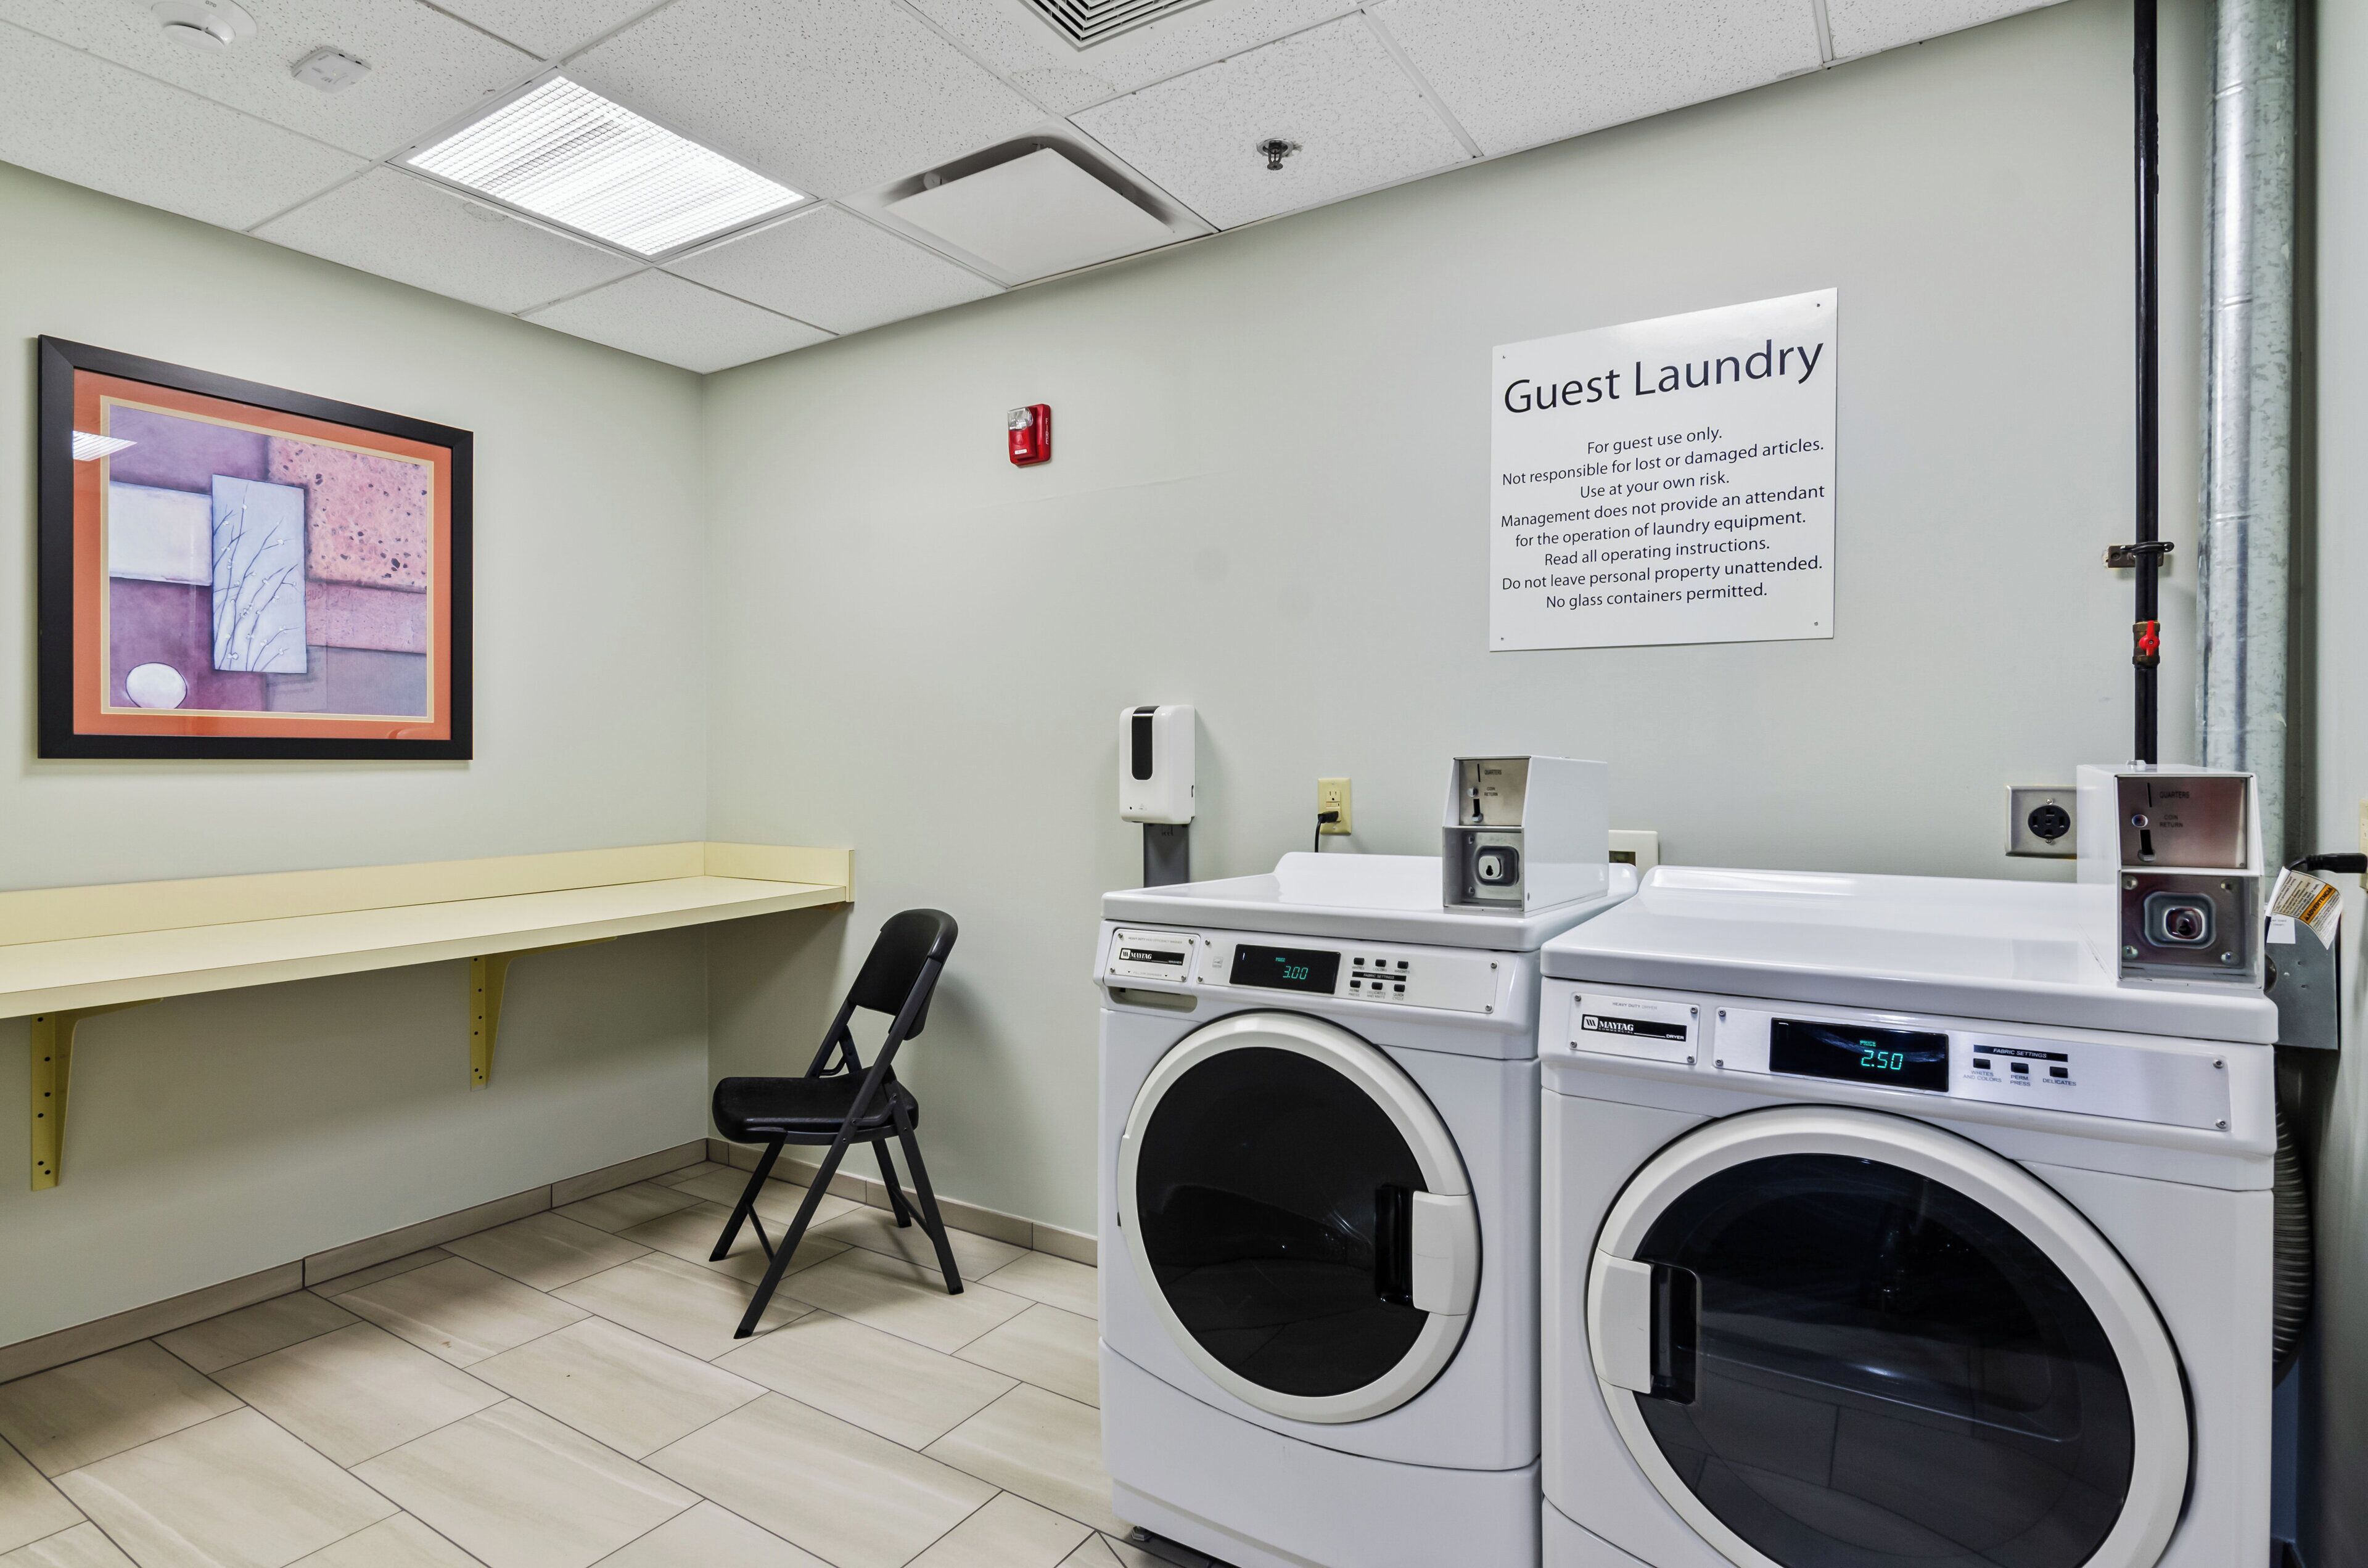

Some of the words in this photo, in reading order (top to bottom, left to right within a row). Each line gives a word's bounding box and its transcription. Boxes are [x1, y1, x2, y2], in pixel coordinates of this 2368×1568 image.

[1505, 369, 1621, 413] Guest
[1635, 339, 1824, 396] Laundry
[1588, 441, 1610, 454] For
[1613, 436, 1653, 454] guest
[1658, 434, 1682, 445] use
[1687, 427, 1722, 443] only.
[1503, 473, 1526, 486] Not
[1531, 462, 1608, 483] responsible
[1612, 460, 1632, 474] for
[1635, 458, 1661, 470] lost
[1665, 456, 1681, 467] or
[1685, 443, 1758, 465] damaged
[1762, 438, 1823, 456] articles.
[1581, 486, 1605, 498] Use
[1610, 483, 1622, 495] at
[1627, 481, 1659, 497] your
[1663, 477, 1695, 490] own
[1700, 470, 1729, 486] risk.
[1501, 509, 1590, 528] Management
[1594, 506, 1627, 519] does
[1632, 502, 1656, 515] not
[1661, 495, 1717, 515] provide
[1722, 496, 1740, 507] an
[1745, 486, 1825, 504] attendant
[1516, 534, 1534, 547] for
[1537, 532, 1559, 545] the
[1563, 527, 1630, 545] operation
[1634, 522, 1650, 536] of
[1653, 519, 1710, 535] laundry
[1714, 512, 1806, 532] equipment.
[1545, 551, 1577, 566] Read
[1582, 549, 1597, 563] all
[1601, 545, 1671, 564] operating
[1676, 539, 1770, 556] instructions.
[1503, 578, 1521, 589] Do
[1524, 577, 1547, 588] not
[1551, 574, 1585, 586] leave
[1590, 567, 1650, 587] personal
[1655, 565, 1720, 583] property
[1725, 555, 1822, 575] unattended.
[1547, 596, 1565, 608] No
[1569, 593, 1602, 610] glass
[1607, 589, 1682, 604] containers
[1687, 582, 1767, 604] permitted.
[2307, 887, 2333, 917] ADVERTENCIA
[1283, 965, 1309, 980] 3.00
[1598, 1020, 1634, 1032] MAYTAG
[1860, 1049, 1904, 1070] 2.50
[2016, 1050, 2047, 1058] SETTINGS
[2042, 1078, 2077, 1086] DELICATES
